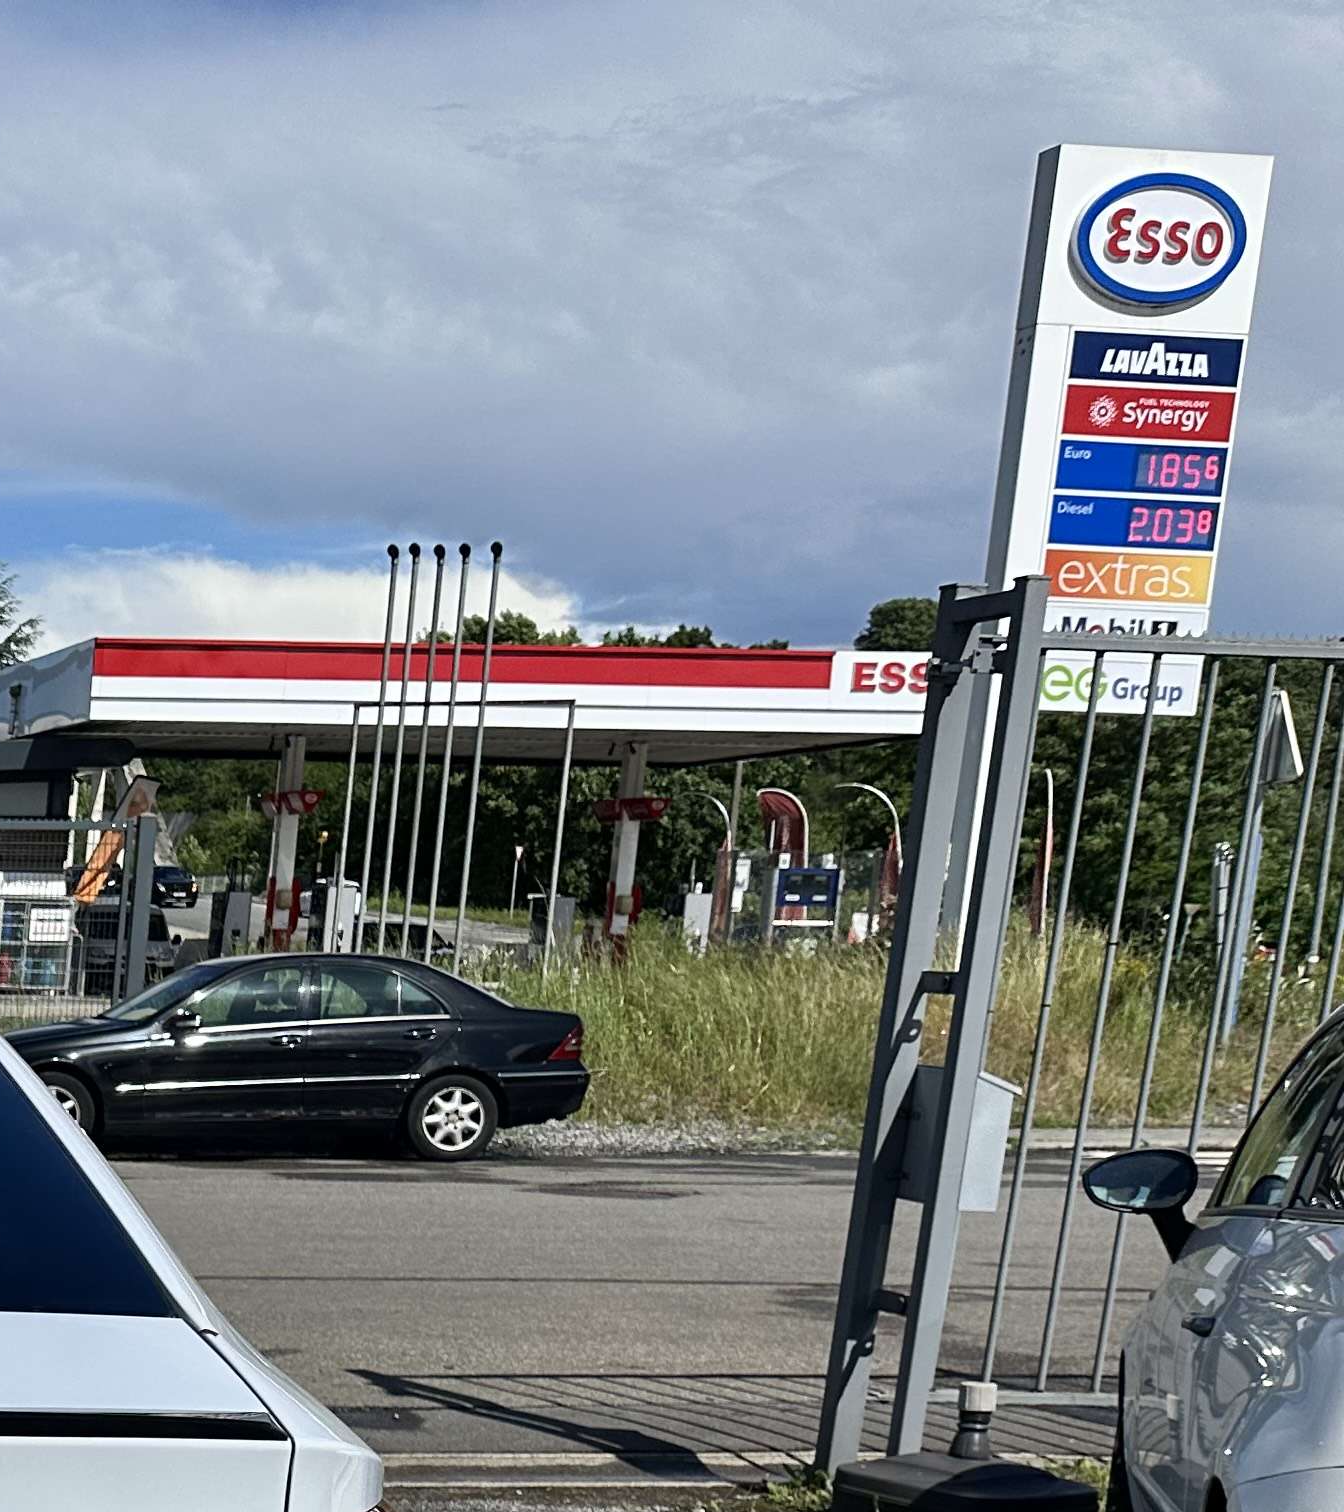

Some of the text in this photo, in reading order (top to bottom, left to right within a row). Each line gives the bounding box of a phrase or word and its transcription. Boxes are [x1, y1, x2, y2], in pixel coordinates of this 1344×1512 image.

[1100, 342, 1209, 378] LAVAZZA
[1139, 397, 1210, 409] FUEL TECHNOLOGY
[1122, 401, 1209, 432] Synergy
[1063, 446, 1092, 460] Euro
[1057, 501, 1094, 515] Diesel
[850, 662, 928, 694] ESS
